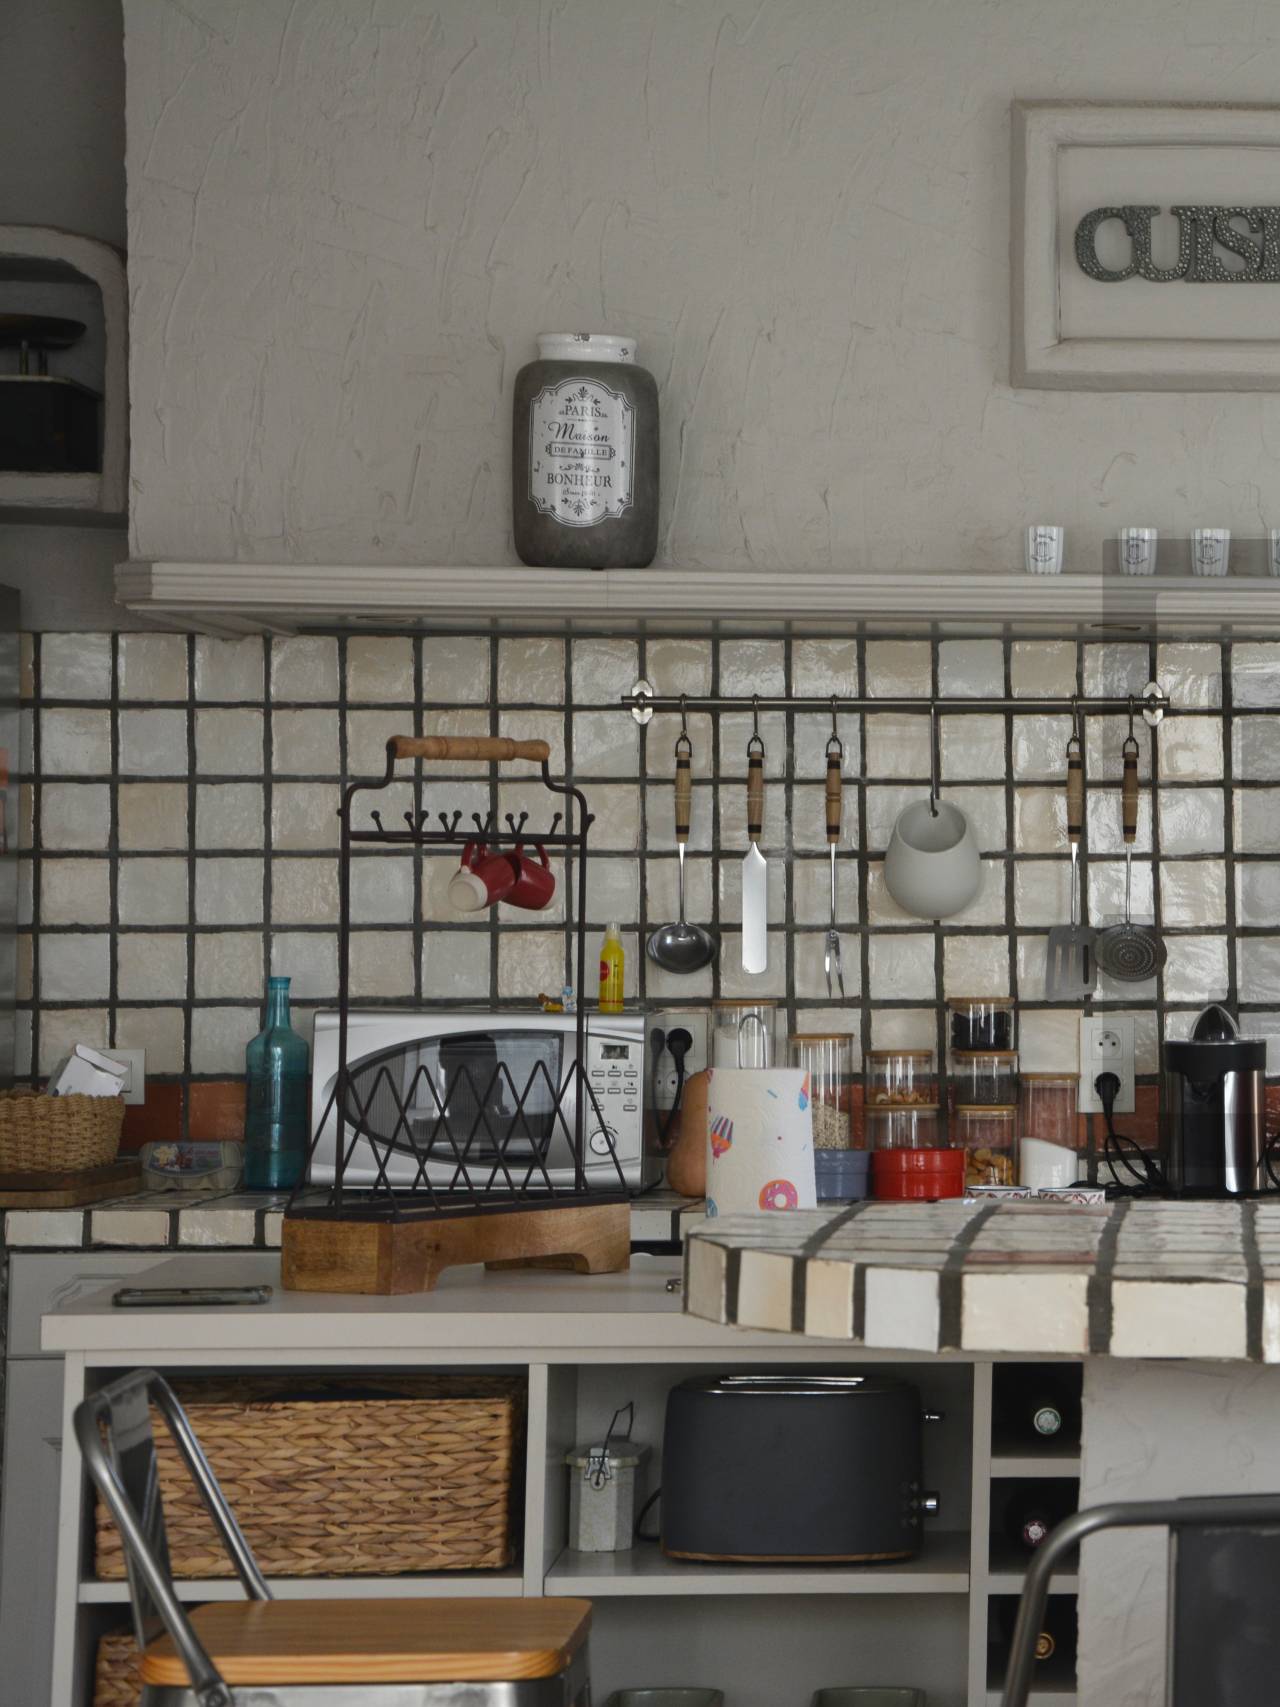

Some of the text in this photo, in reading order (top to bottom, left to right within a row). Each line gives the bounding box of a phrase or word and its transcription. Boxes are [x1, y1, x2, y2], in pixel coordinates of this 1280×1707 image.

[565, 405, 601, 418] PARIS
[548, 421, 610, 443] Maison
[554, 446, 607, 456] DE FAMILLE
[547, 473, 612, 488] BONHEUR
